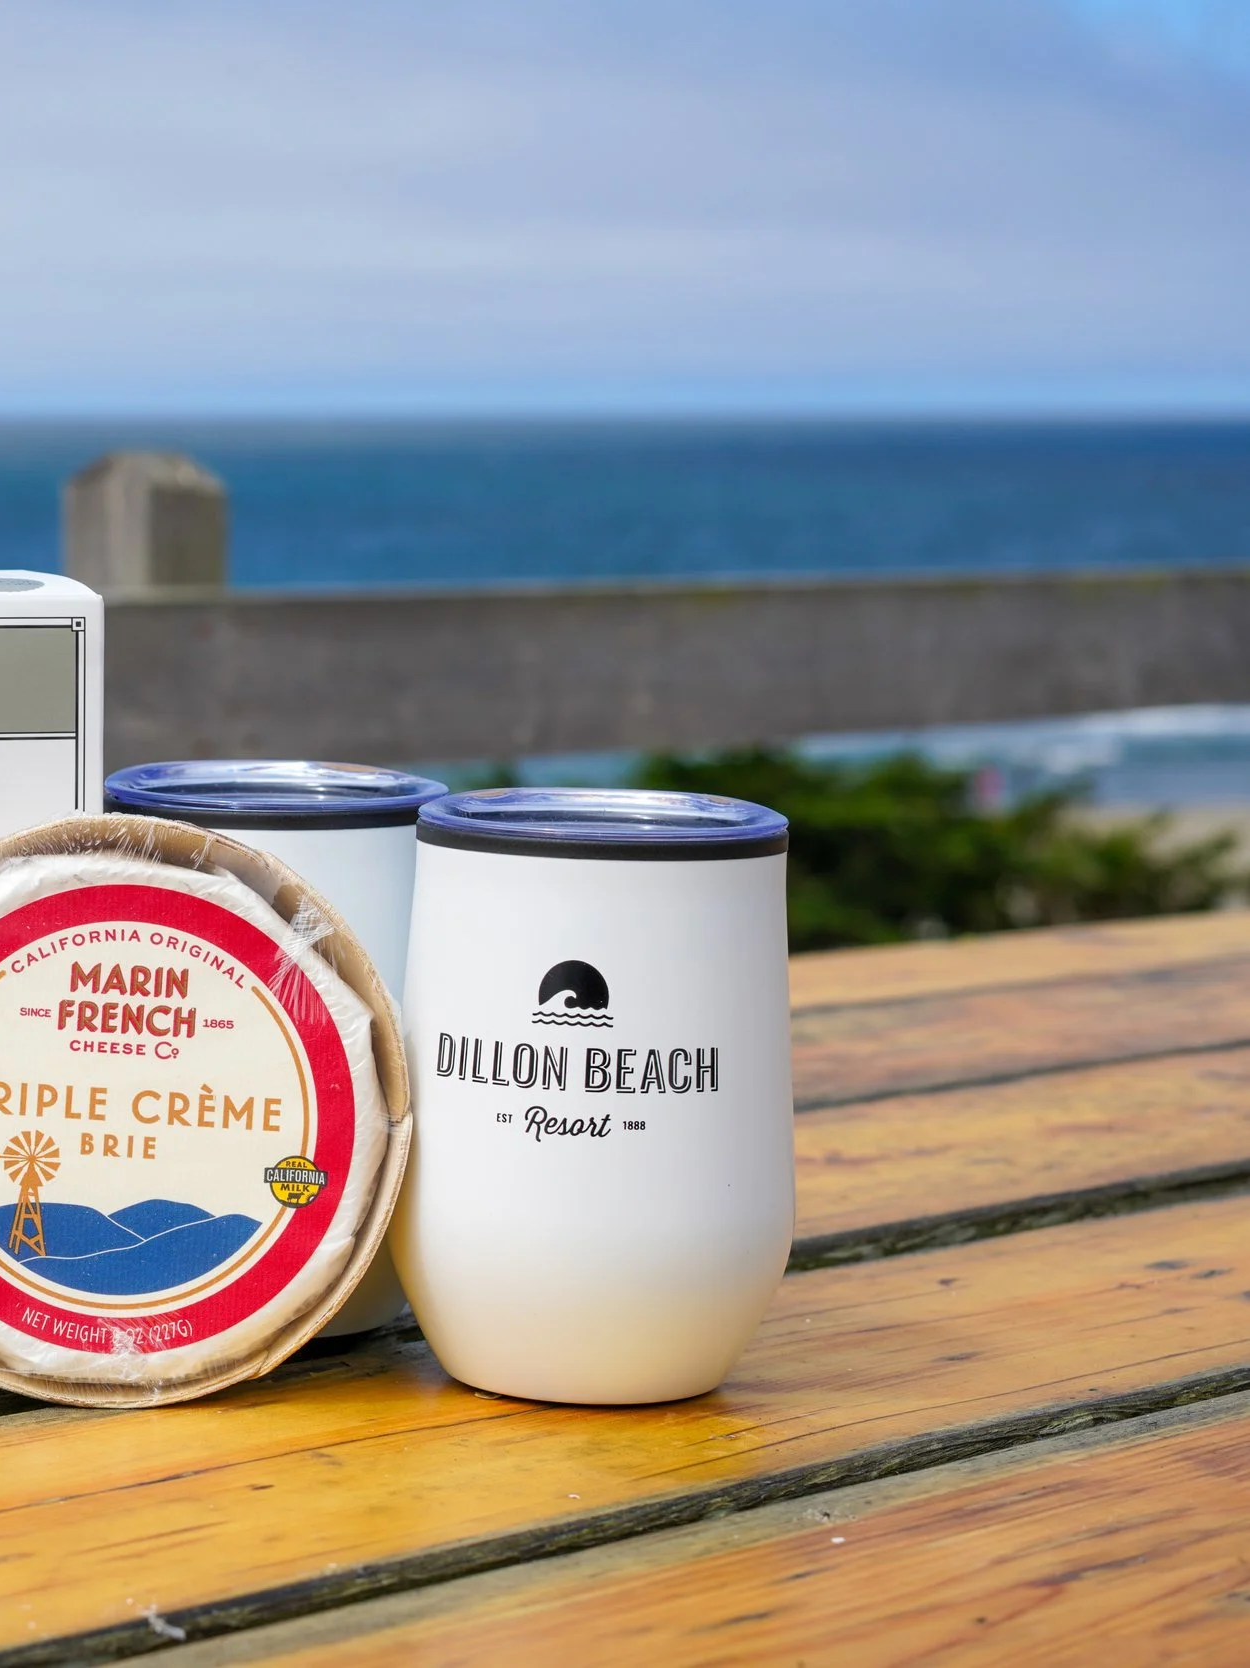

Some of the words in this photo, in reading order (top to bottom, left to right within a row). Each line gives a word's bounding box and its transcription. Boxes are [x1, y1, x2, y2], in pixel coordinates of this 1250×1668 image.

[11, 929, 141, 974] CALIFORNIA
[150, 932, 246, 989] ORIGINAL
[69, 961, 190, 999] MARIN
[19, 1007, 51, 1018] SINCE
[57, 999, 197, 1038] FRENCH
[202, 1018, 235, 1030] 1865
[69, 1040, 147, 1056] CHEESE
[436, 1032, 568, 1092] DILLON
[584, 1046, 719, 1094] BEACH
[131, 1084, 282, 1132] CRÈME
[496, 1113, 513, 1124] EST
[524, 1105, 611, 1143] Resort
[622, 1121, 646, 1131] 1888
[80, 1133, 157, 1159] BRIE
[266, 1169, 325, 1185] CALIFORNIA
[280, 1183, 310, 1192] MILK
[22, 1307, 49, 1330] NET
[53, 1318, 107, 1344] WEIGHT
[150, 1319, 193, 1345] (227G)
